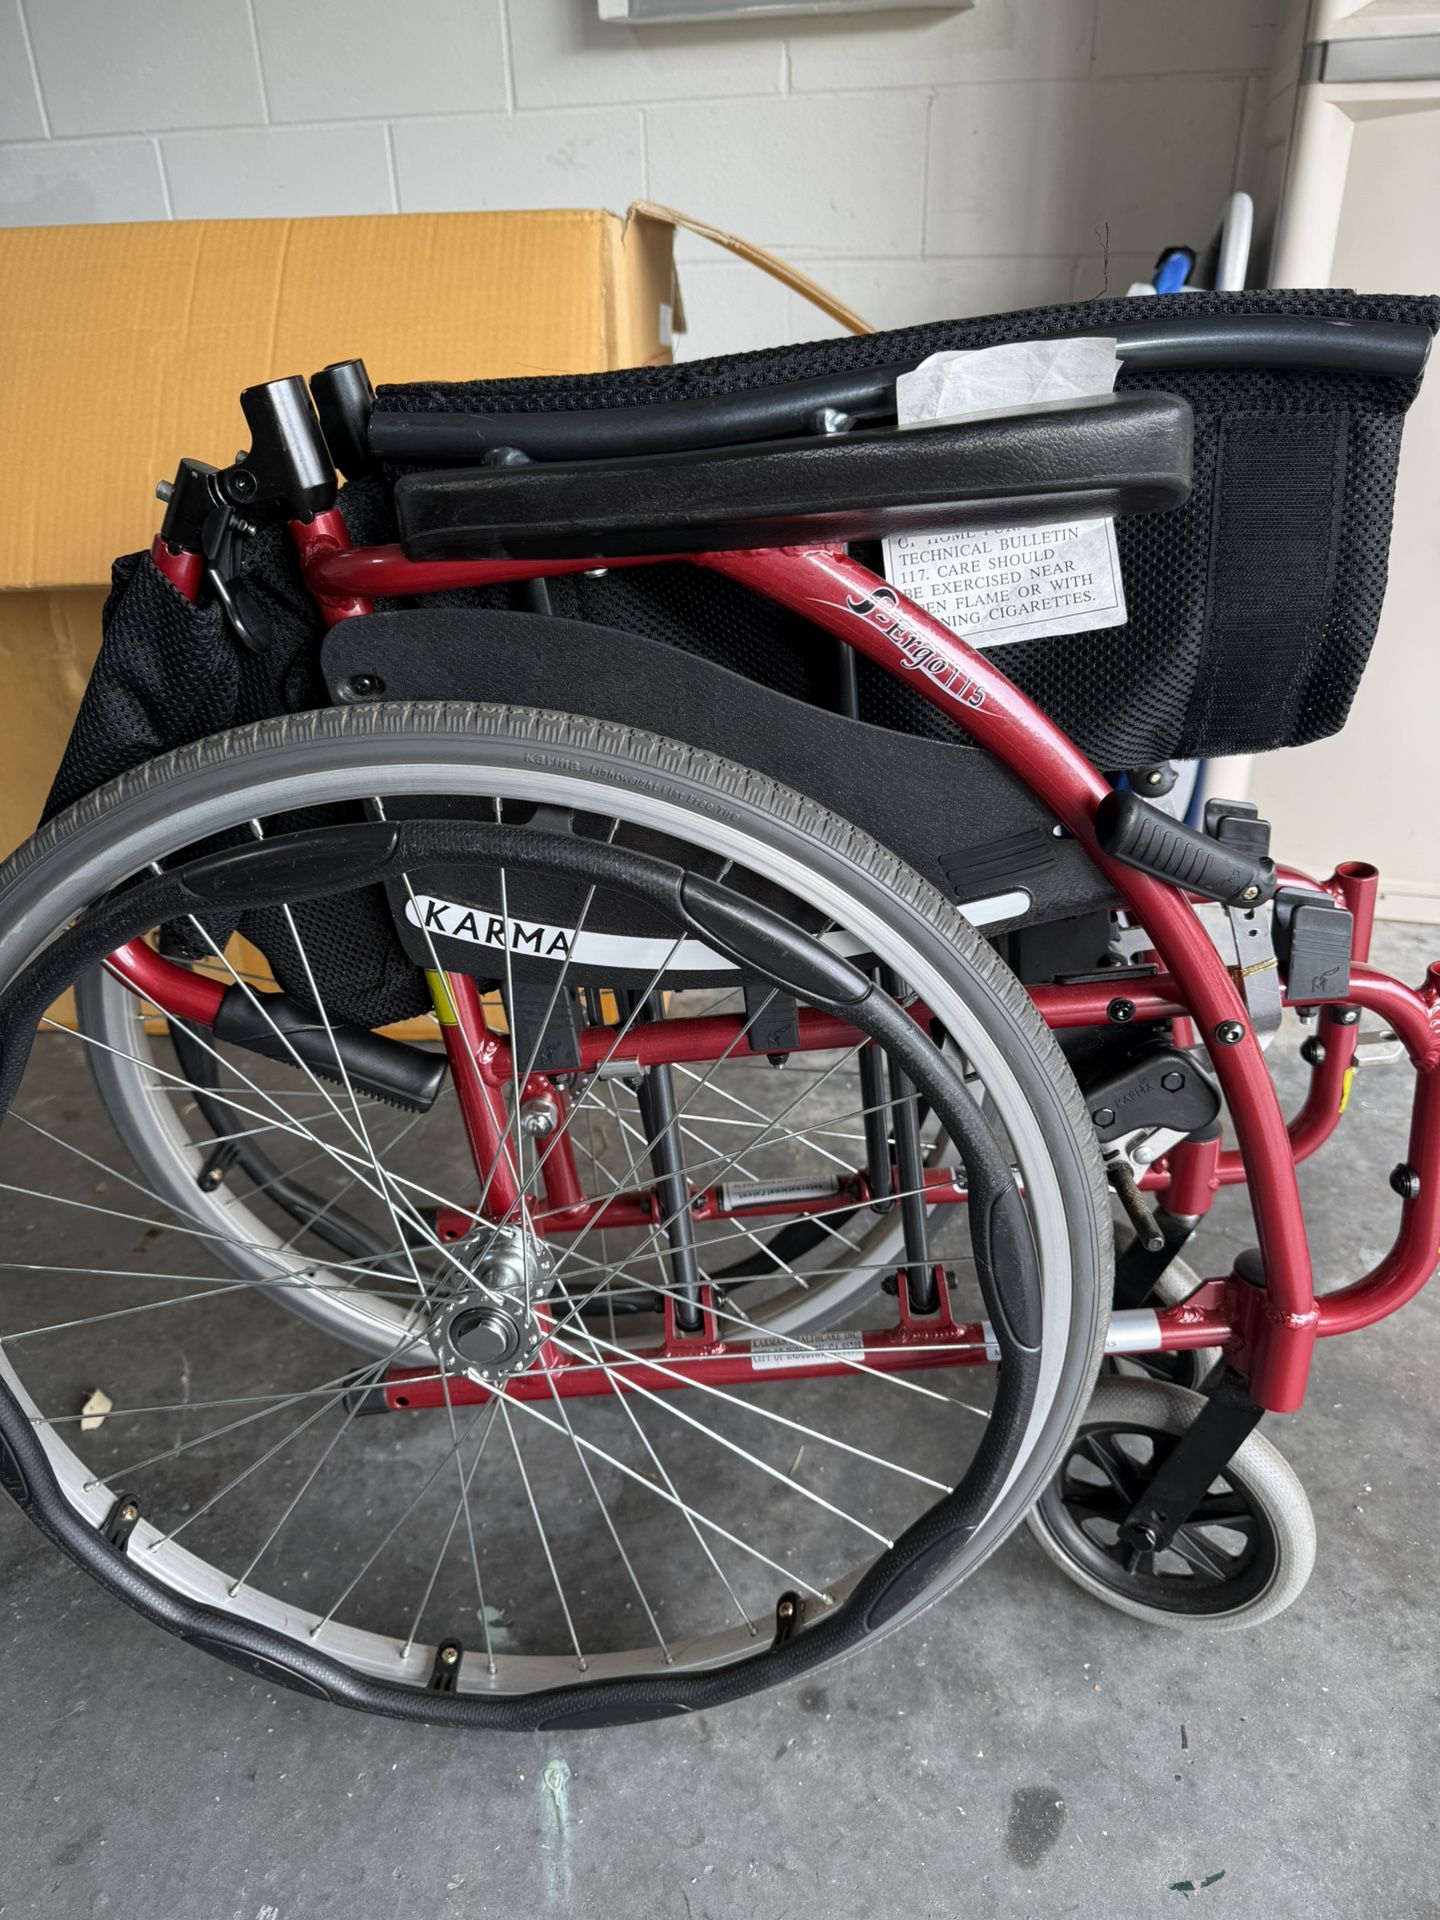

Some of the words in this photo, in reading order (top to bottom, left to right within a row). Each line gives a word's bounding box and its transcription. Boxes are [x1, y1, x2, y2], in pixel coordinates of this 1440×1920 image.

[899, 541, 992, 566] TECHNICAL
[1000, 527, 1079, 551] BULLETIN
[901, 569, 930, 584] 117.
[937, 560, 981, 578] CARE
[988, 548, 1055, 570] SHOULD
[903, 587, 923, 599] BE
[932, 572, 1022, 596] EXERCISED
[1030, 560, 1075, 579] NEAR
[956, 590, 1009, 609] FLAME
[1018, 584, 1041, 598] OR
[1050, 573, 1093, 591] WITH
[989, 590, 1095, 621] CIGARETTES.
[424, 900, 572, 957] KARMA
